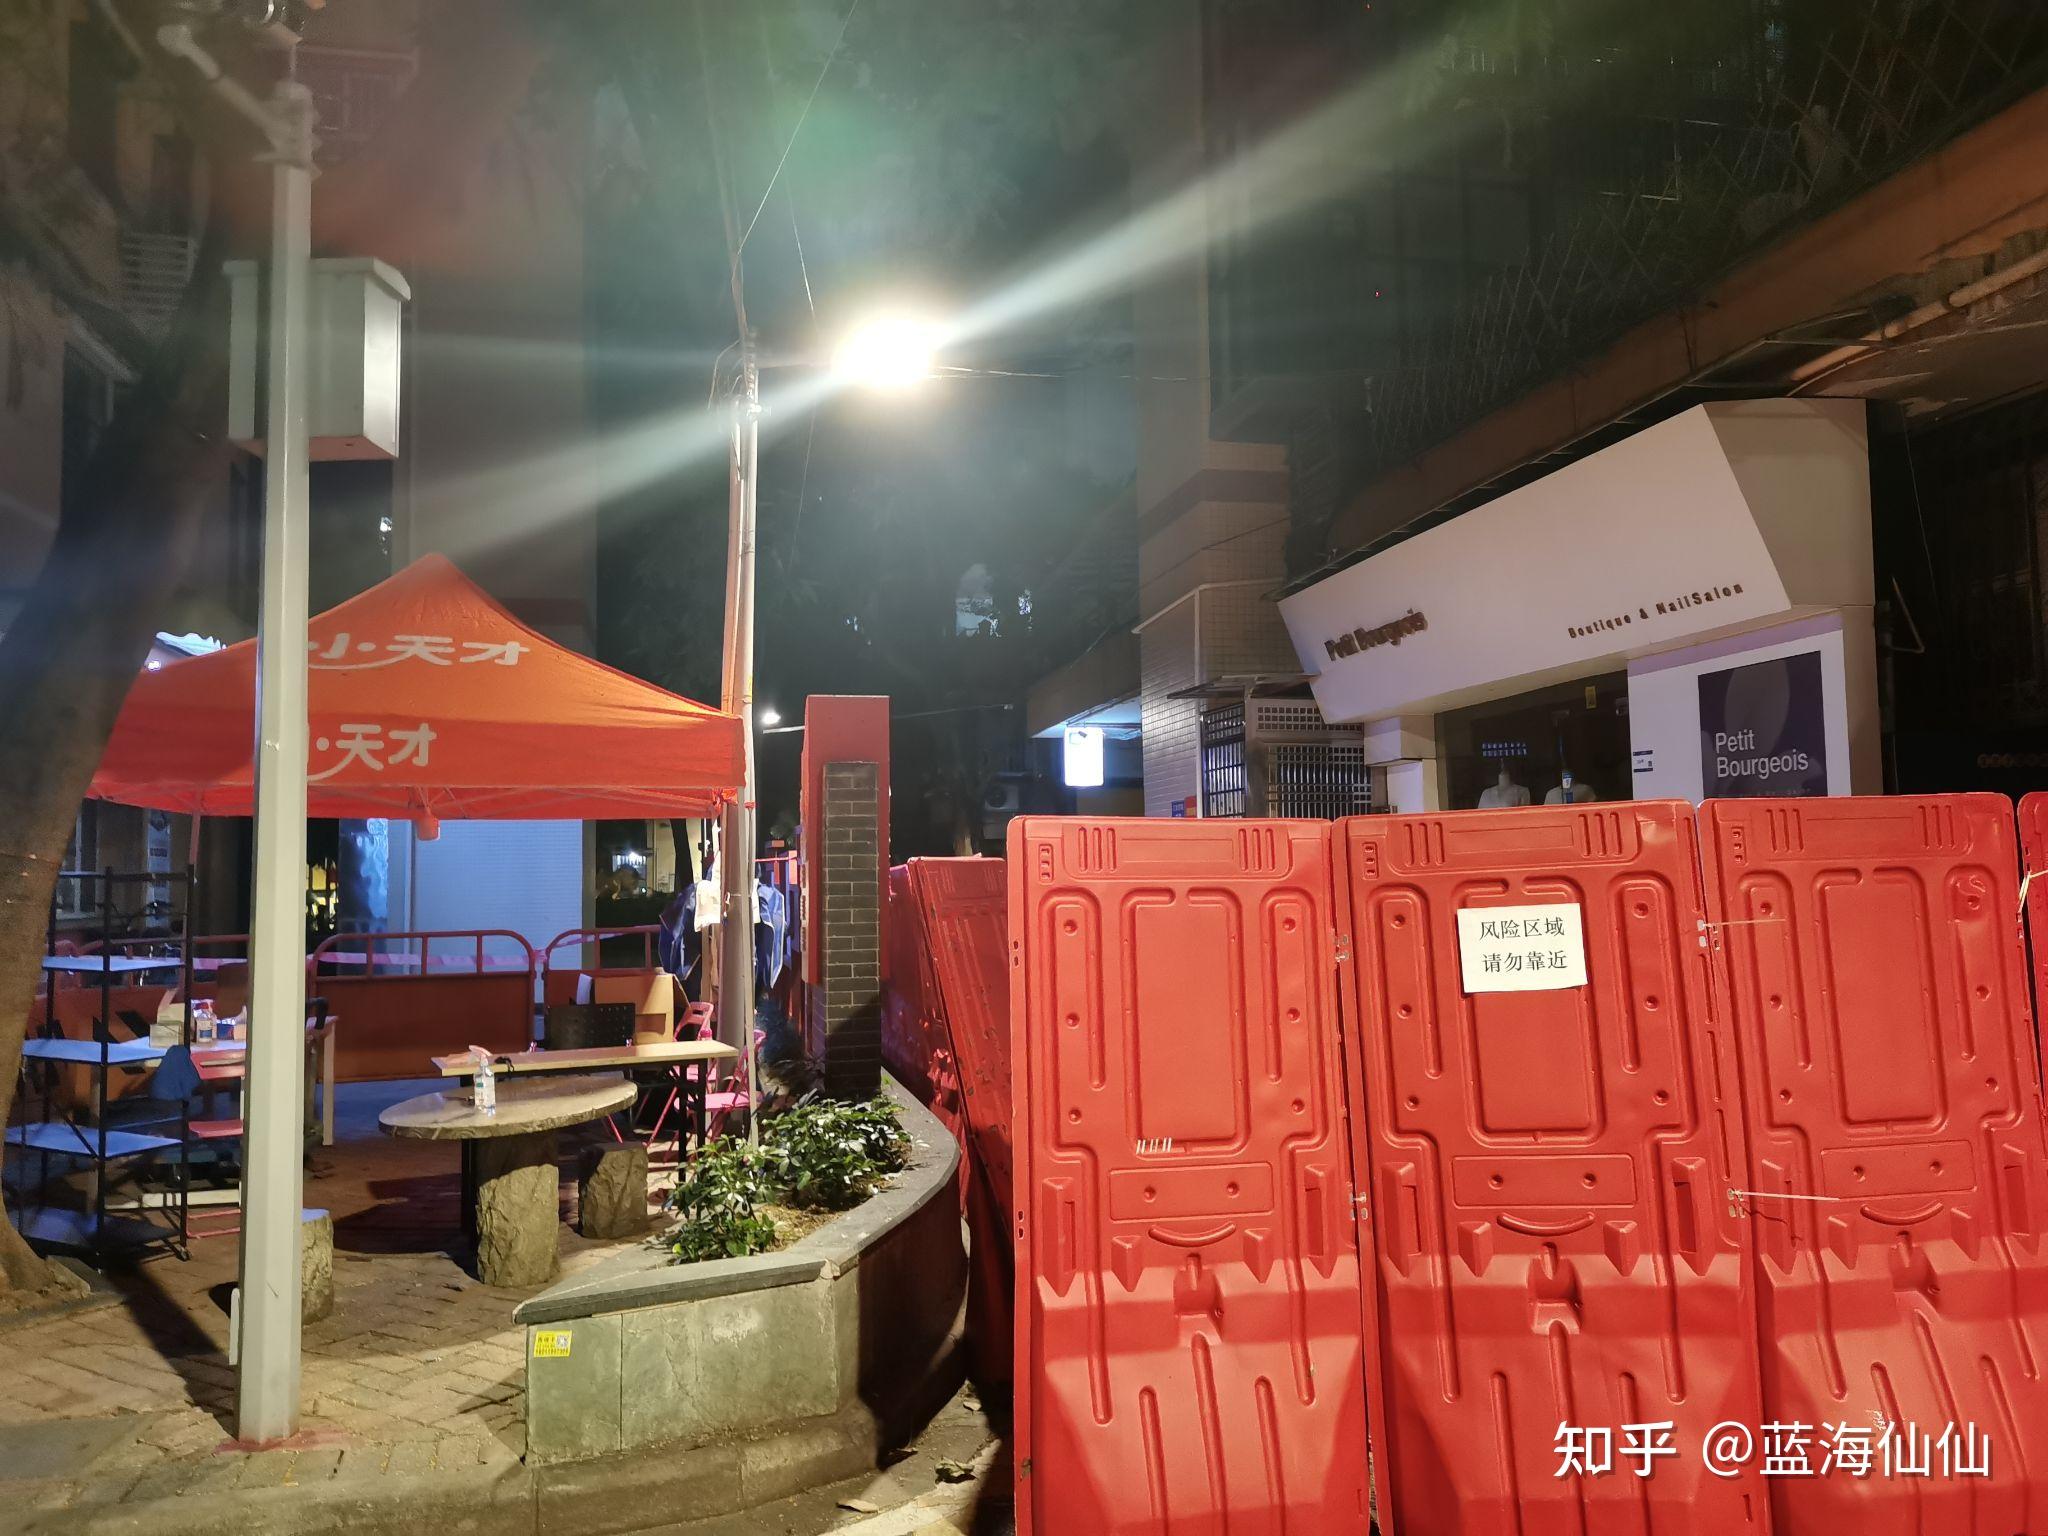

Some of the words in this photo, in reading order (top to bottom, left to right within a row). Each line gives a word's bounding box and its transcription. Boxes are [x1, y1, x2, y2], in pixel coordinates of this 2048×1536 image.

[1568, 614, 1632, 638] Boutique
[1639, 608, 1649, 620] &
[1715, 729, 1756, 754] Petit
[1716, 748, 1809, 780] Bourgeois
[1479, 916, 1566, 940] 风险区域
[1482, 950, 1568, 973] 请勿靠近
